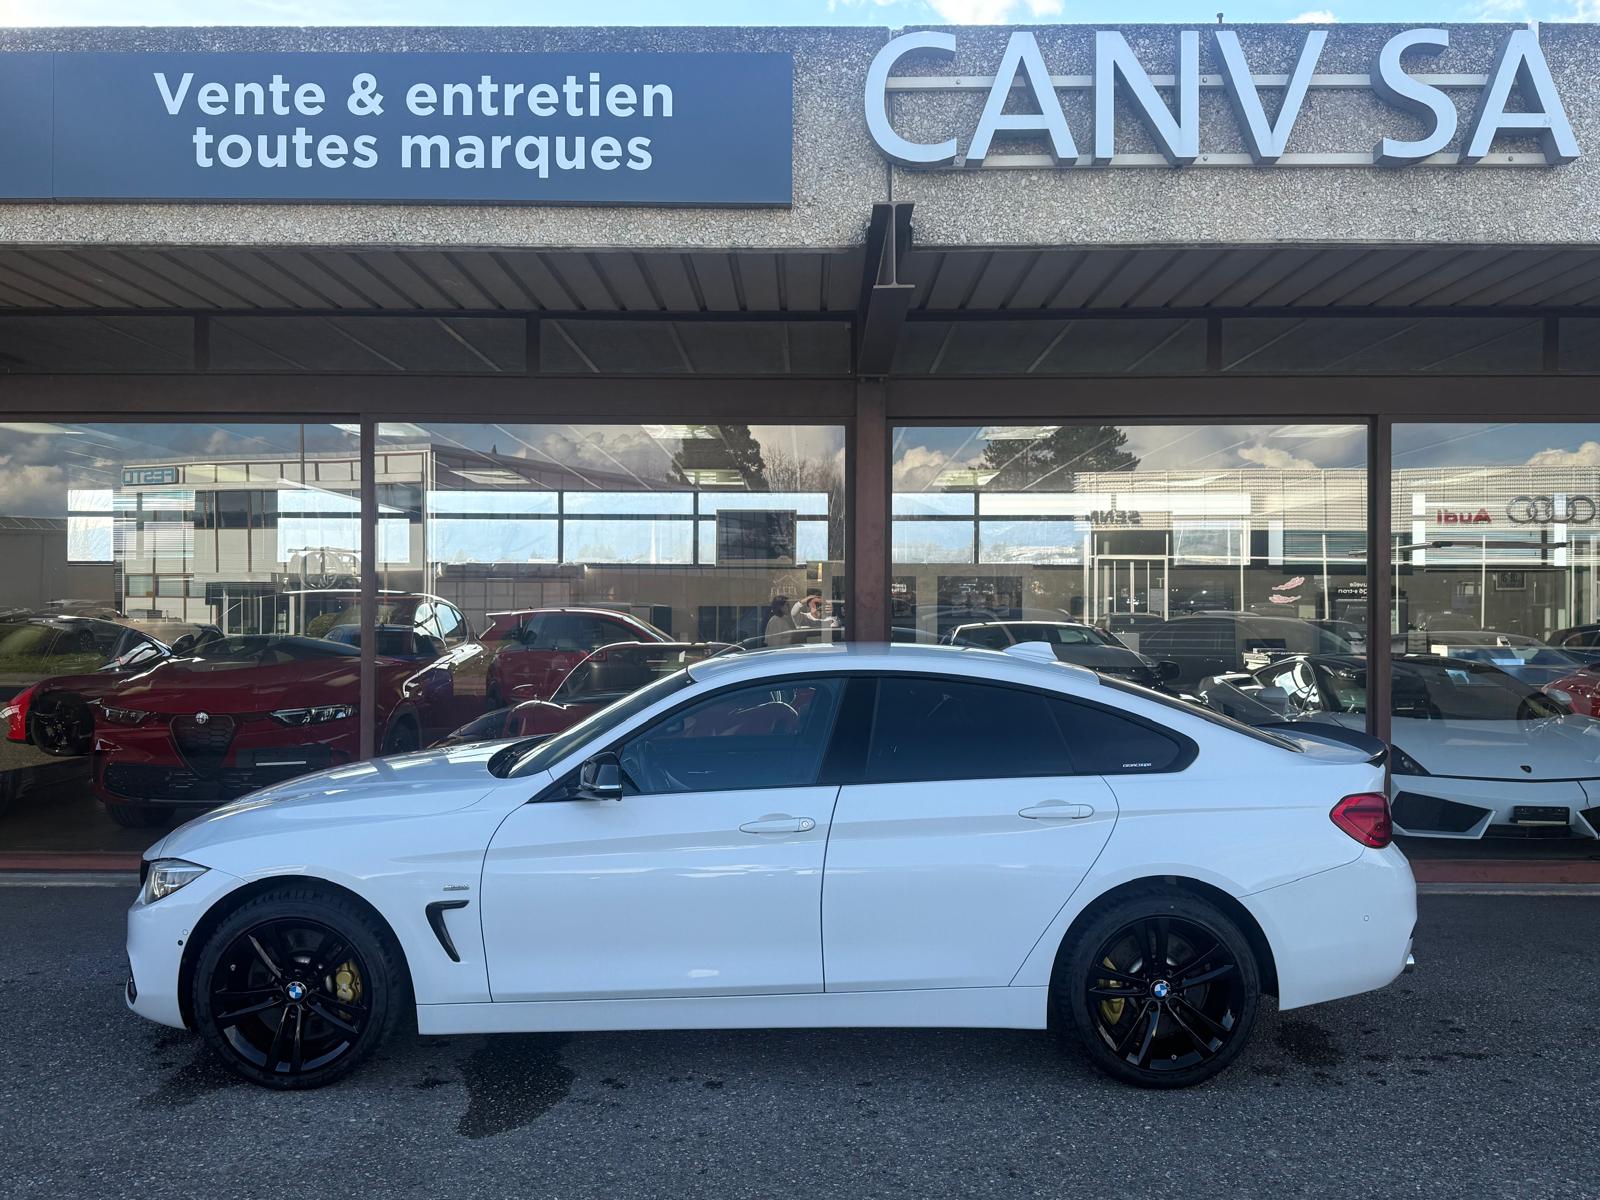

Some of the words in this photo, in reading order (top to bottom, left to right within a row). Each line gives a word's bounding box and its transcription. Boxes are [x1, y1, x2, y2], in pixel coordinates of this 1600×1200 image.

[153, 72, 326, 116] Vente
[346, 72, 385, 116] &
[405, 71, 674, 118] entretien
[863, 29, 1329, 166] CANV
[1374, 28, 1580, 165] SA
[192, 126, 379, 169] toutes
[401, 134, 653, 179] marques
